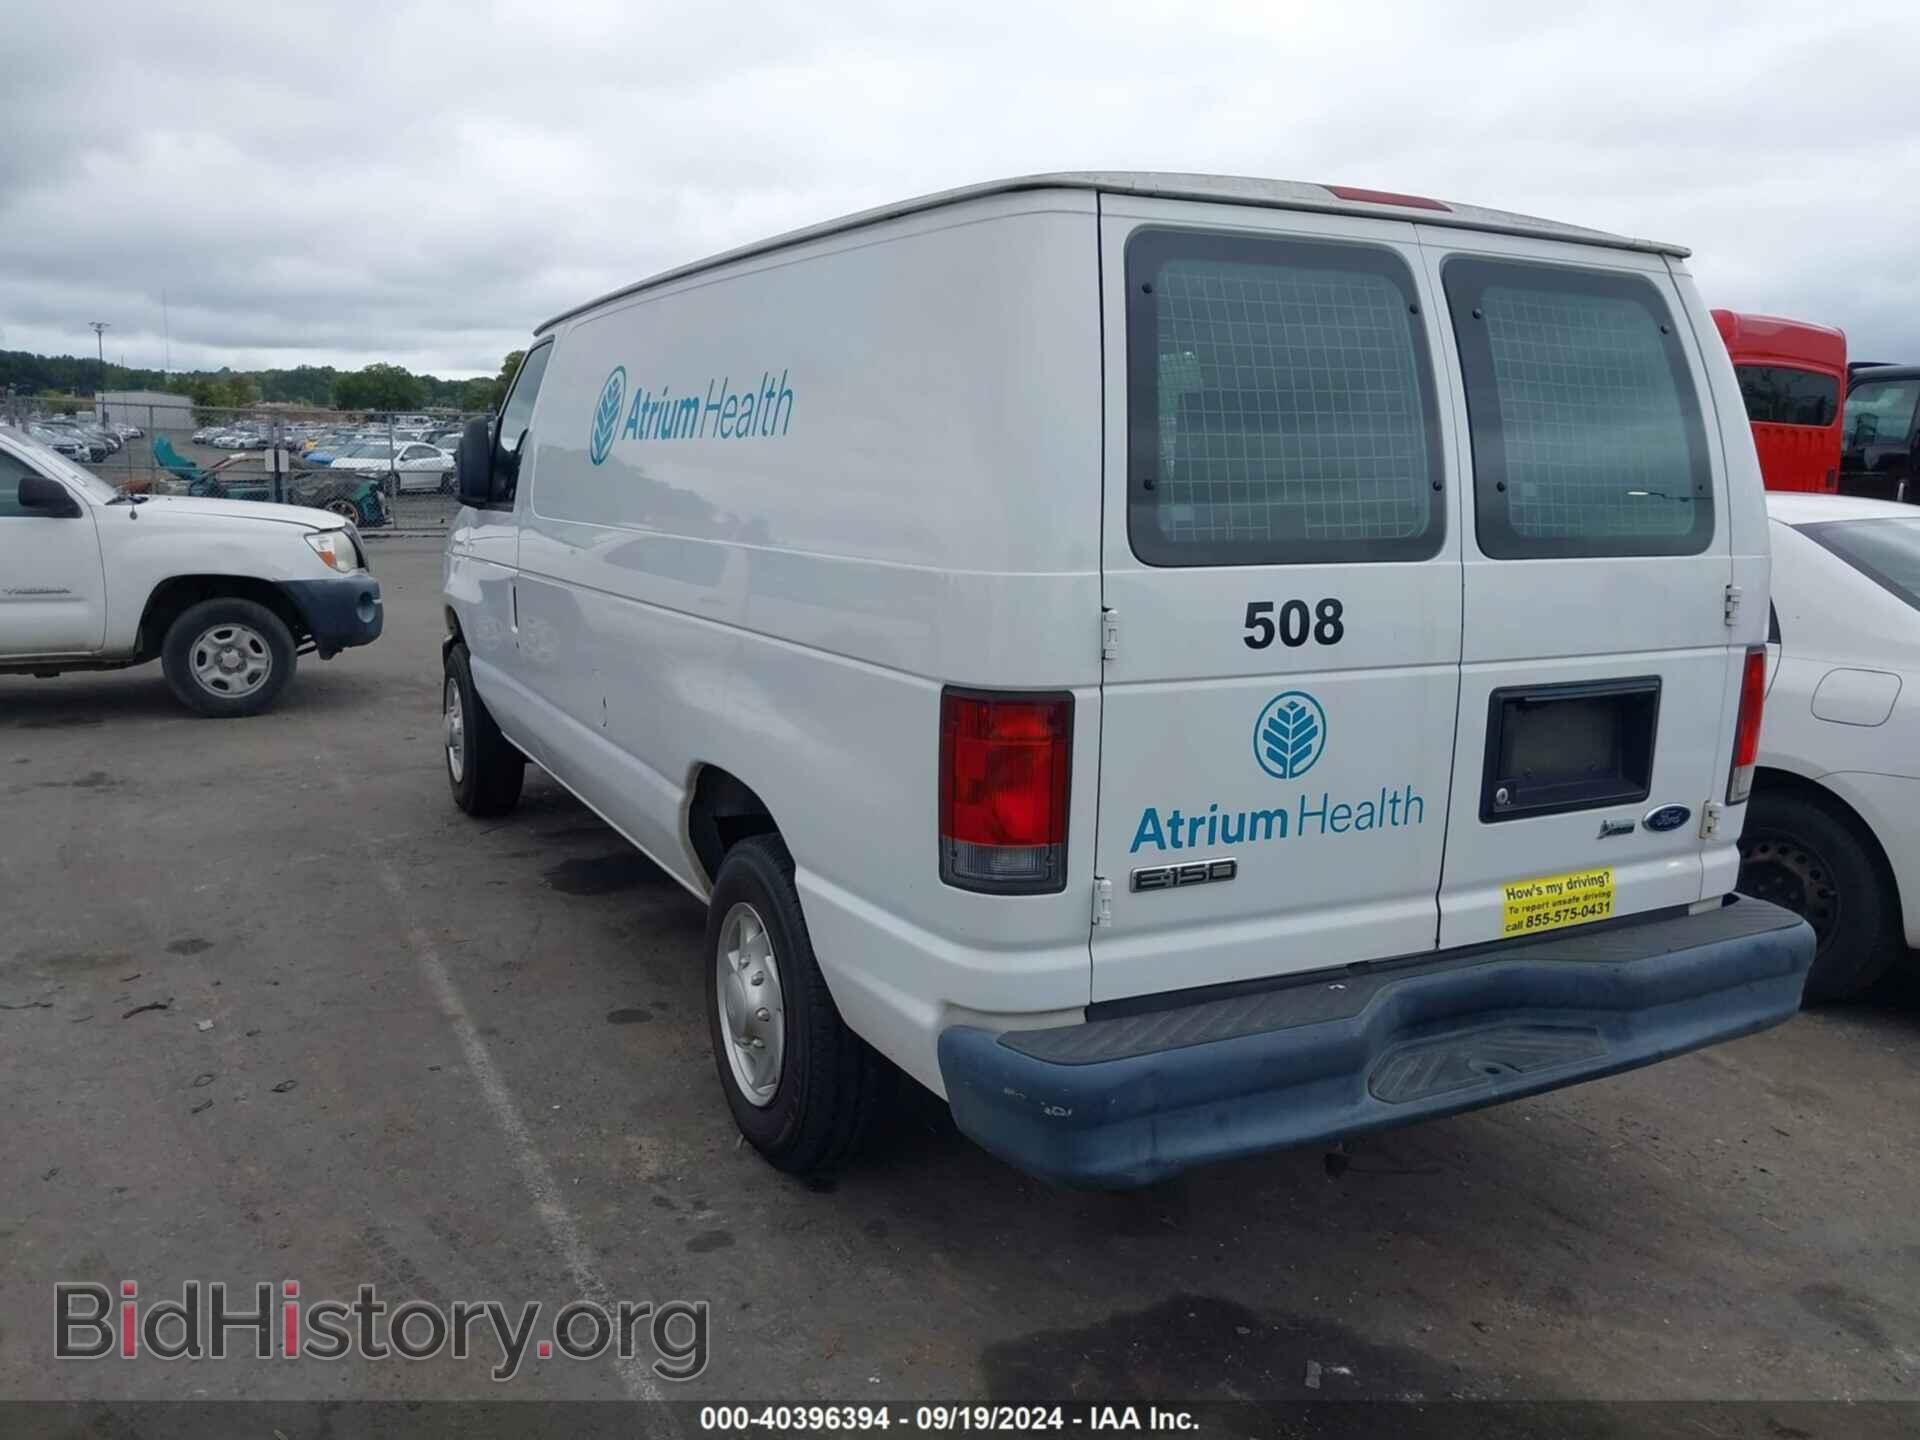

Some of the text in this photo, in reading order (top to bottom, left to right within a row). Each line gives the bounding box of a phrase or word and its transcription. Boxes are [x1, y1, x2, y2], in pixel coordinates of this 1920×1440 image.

[621, 369, 793, 440] Atrium Health
[1243, 597, 1344, 649] 508
[1129, 784, 1424, 853] Atrium Health
[1506, 872, 1610, 900] How's my driving?
[1509, 890, 1612, 915] To report unsafe driving
[1504, 900, 1611, 932] call 855-575-0431
